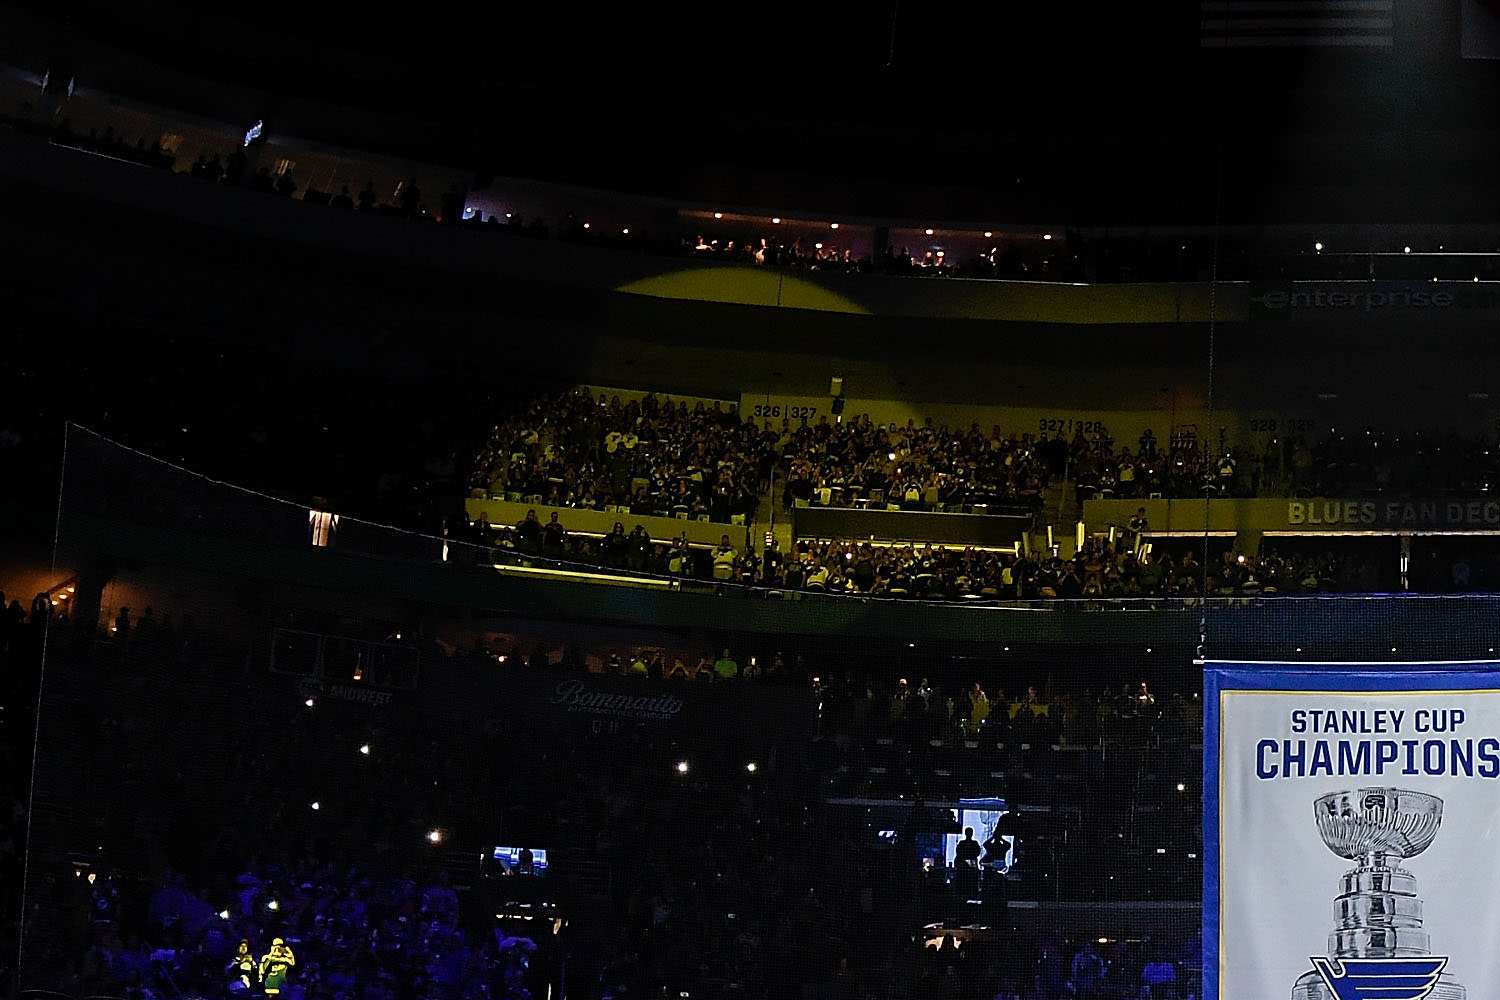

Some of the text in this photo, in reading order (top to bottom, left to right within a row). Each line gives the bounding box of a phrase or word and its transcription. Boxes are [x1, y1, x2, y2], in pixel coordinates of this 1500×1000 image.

[1252, 288, 1455, 312] enterprise
[753, 405, 817, 420] 326 327
[1287, 502, 1377, 526] BLUES
[1386, 502, 1437, 526] FAN
[1292, 709, 1466, 733] STANLEY CUP
[1256, 738, 1500, 780] CHAMPIONS
